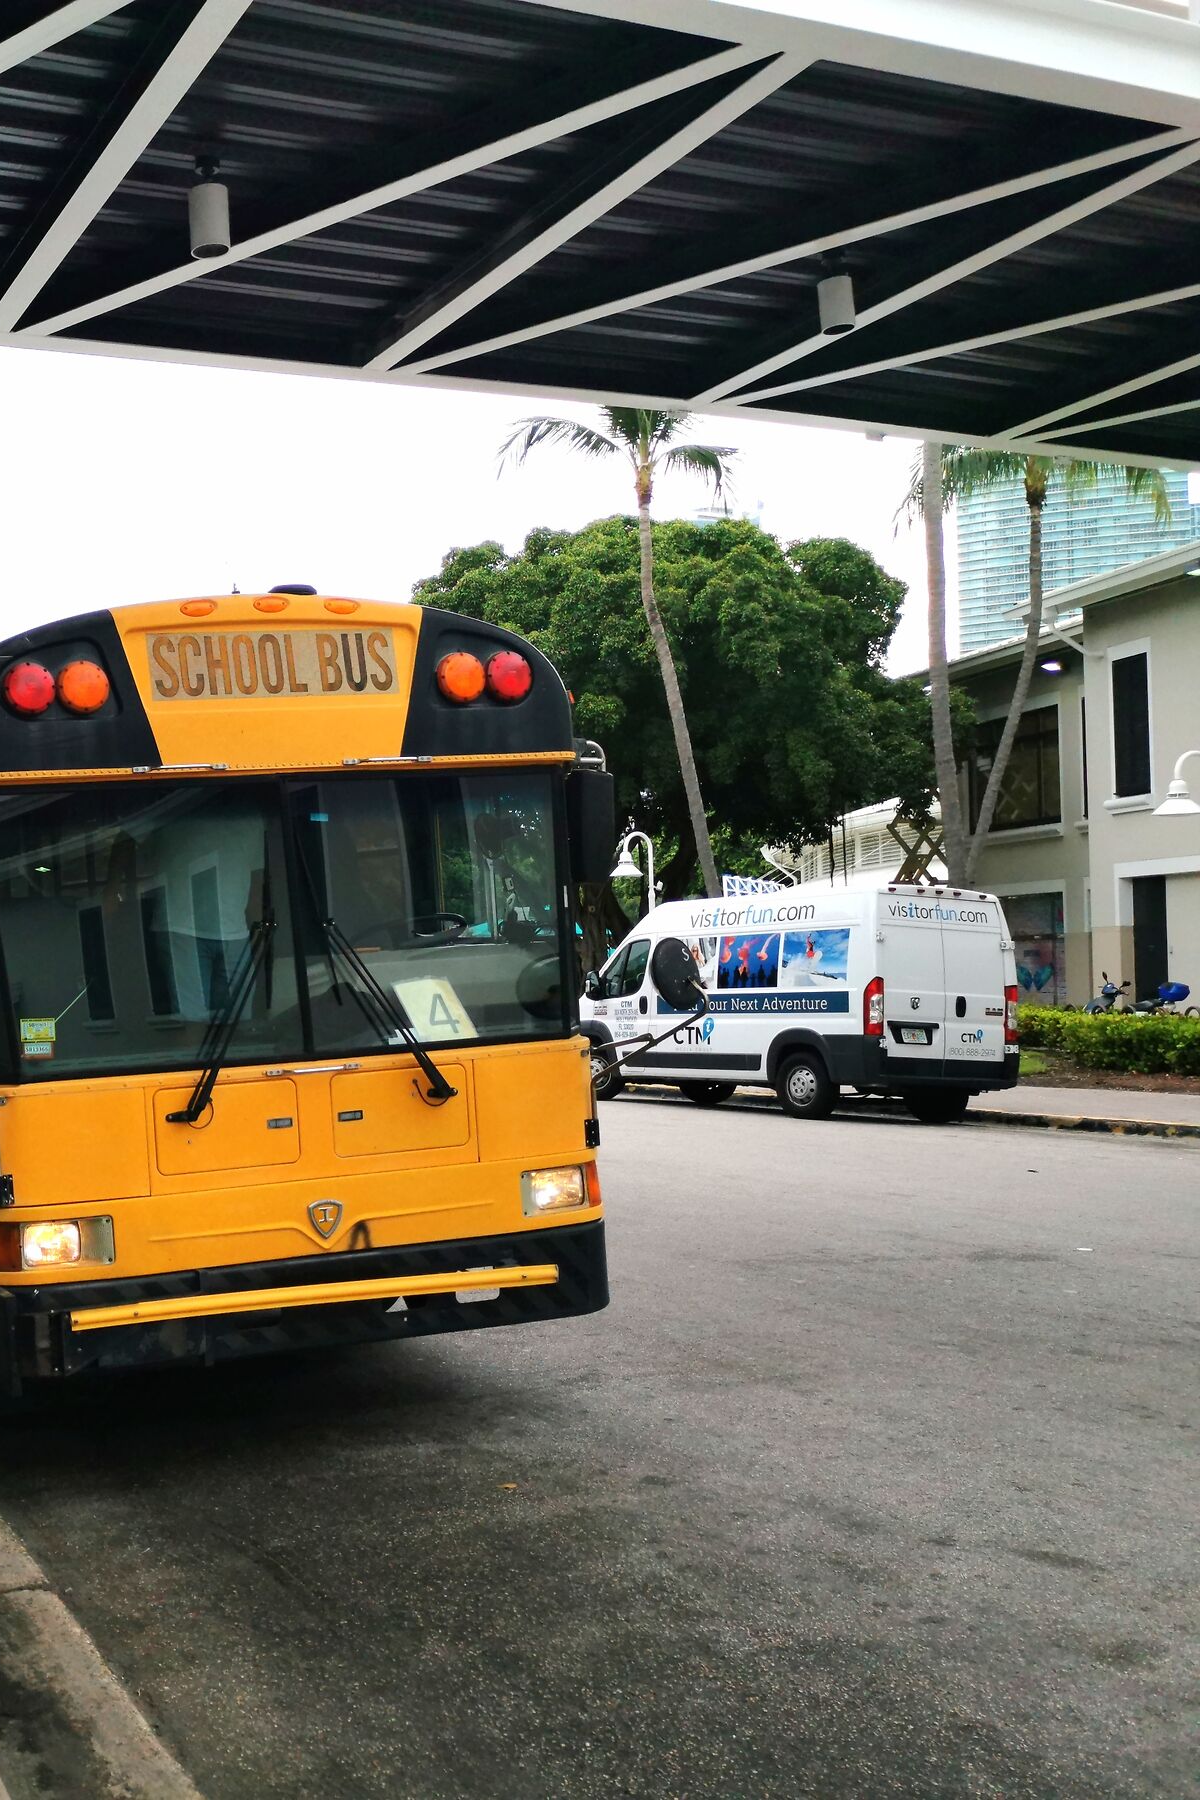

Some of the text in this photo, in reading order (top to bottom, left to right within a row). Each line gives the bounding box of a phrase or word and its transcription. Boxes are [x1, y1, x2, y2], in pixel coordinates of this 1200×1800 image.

[152, 631, 393, 697] SCHOOL BUS
[690, 903, 815, 928] visitorfun.com
[888, 901, 988, 924] visitorfun.com
[429, 993, 460, 1033] 4
[620, 1000, 633, 1008] CTM
[730, 998, 758, 1011] Next
[762, 997, 828, 1011] Adventure
[673, 1027, 711, 1045] CTM
[961, 1032, 982, 1043] CTM
